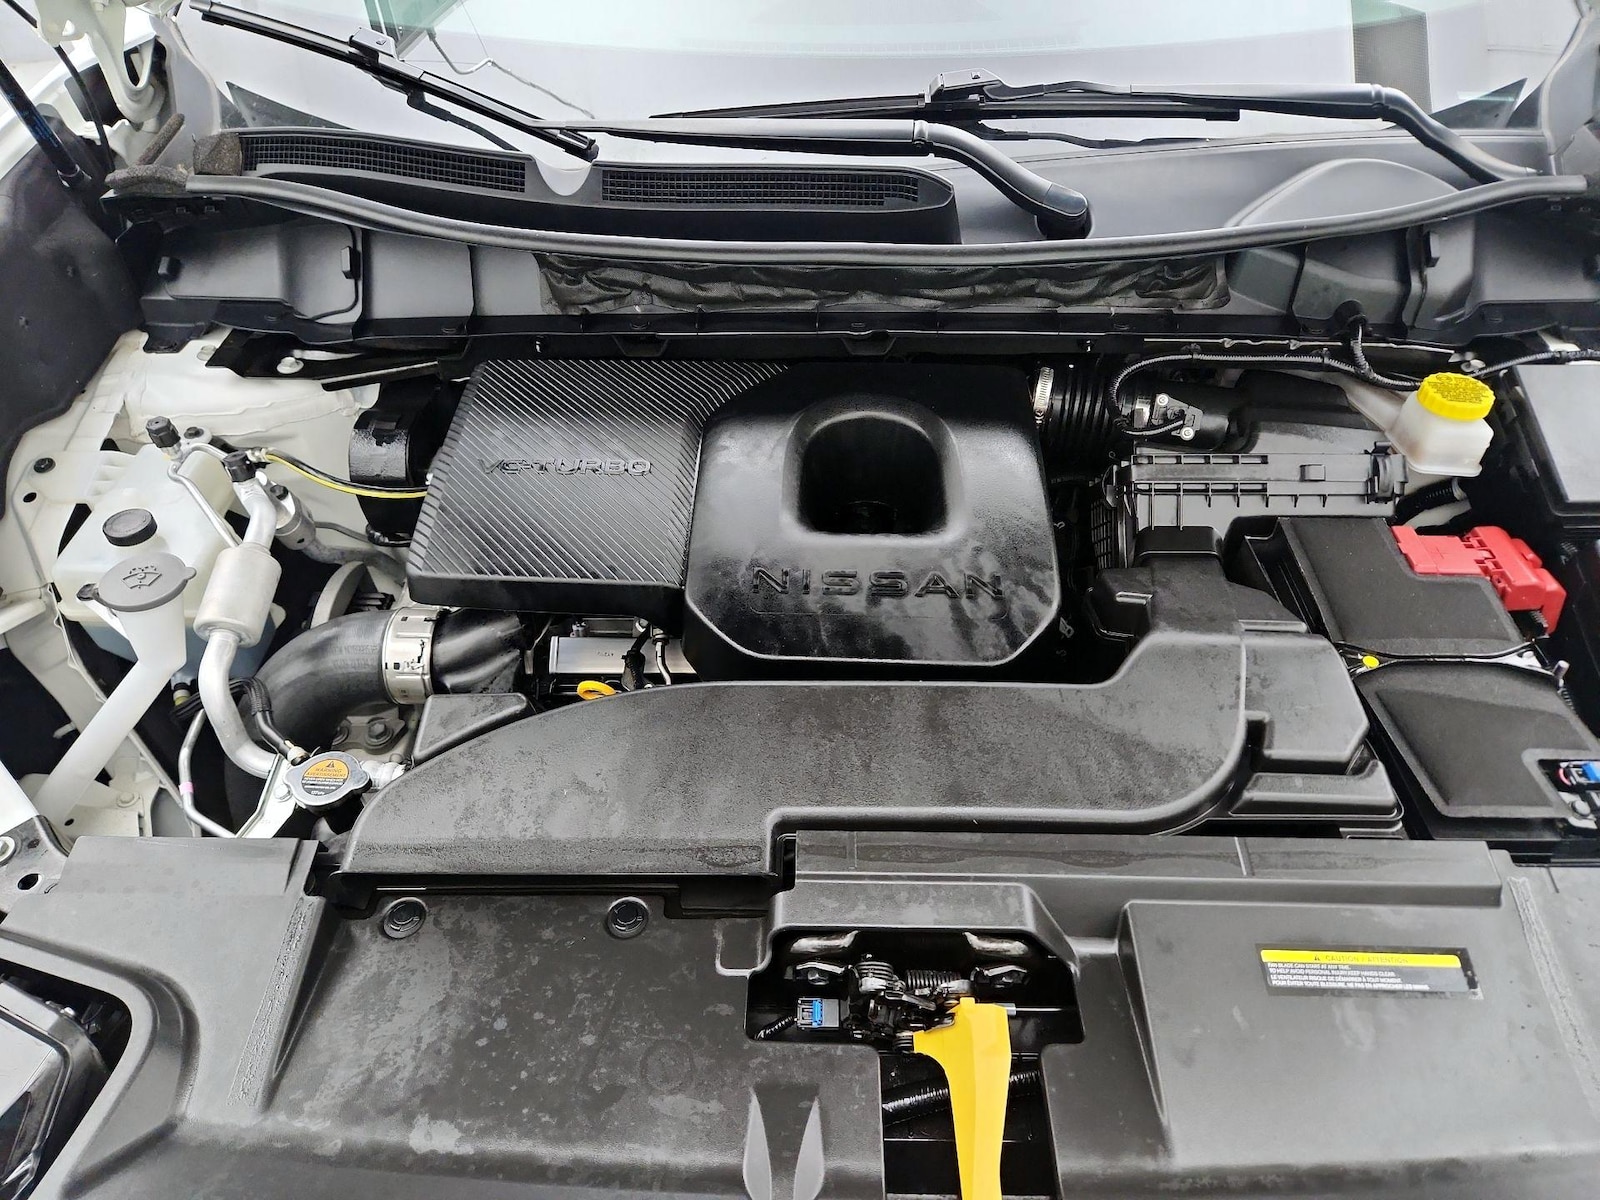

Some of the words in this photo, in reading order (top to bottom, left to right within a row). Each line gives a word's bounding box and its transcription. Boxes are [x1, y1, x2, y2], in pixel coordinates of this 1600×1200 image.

[478, 458, 652, 476] VC-TURBO
[752, 567, 1004, 599] NISSAN
[1325, 954, 1359, 962] CAUTION
[1368, 956, 1409, 964] ATTENTION
